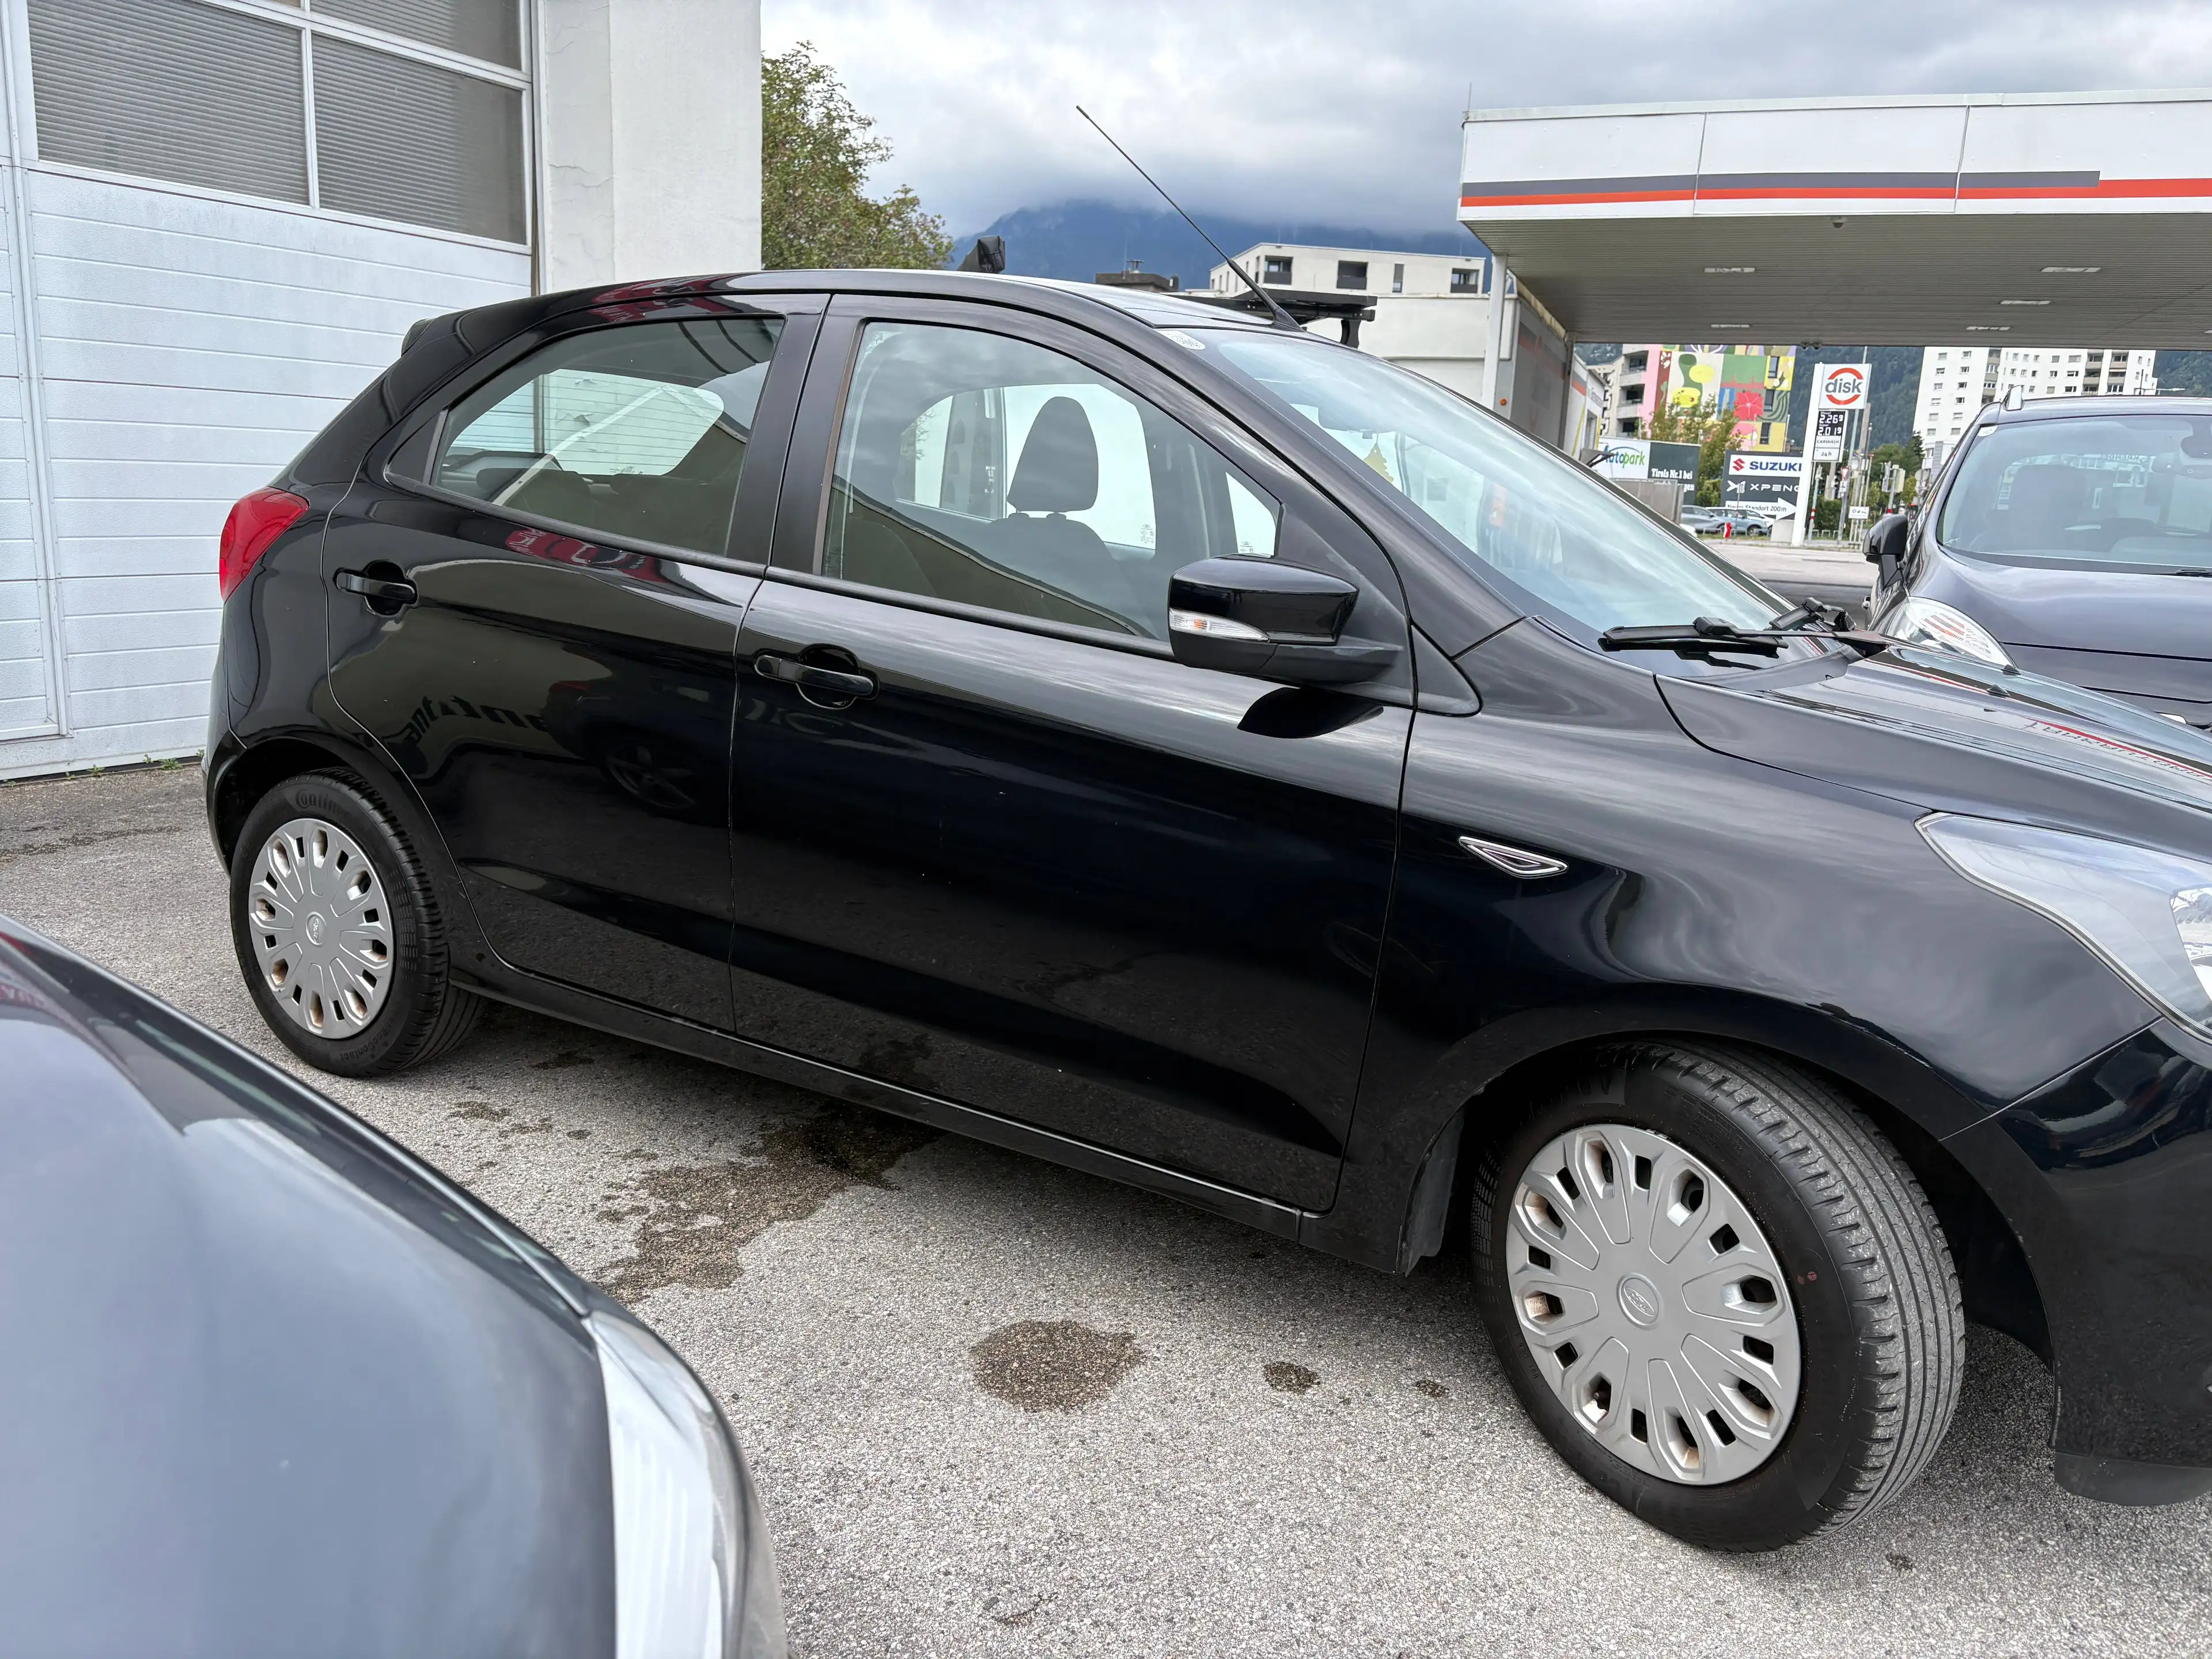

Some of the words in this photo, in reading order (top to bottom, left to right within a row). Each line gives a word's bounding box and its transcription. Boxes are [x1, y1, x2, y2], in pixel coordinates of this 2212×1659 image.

[1825, 378, 1863, 393] disk
[1819, 414, 1843, 424] 2.269
[1749, 461, 1802, 472] SUZUKI
[1651, 468, 1669, 479] Tirols
[1683, 469, 1693, 480] bei
